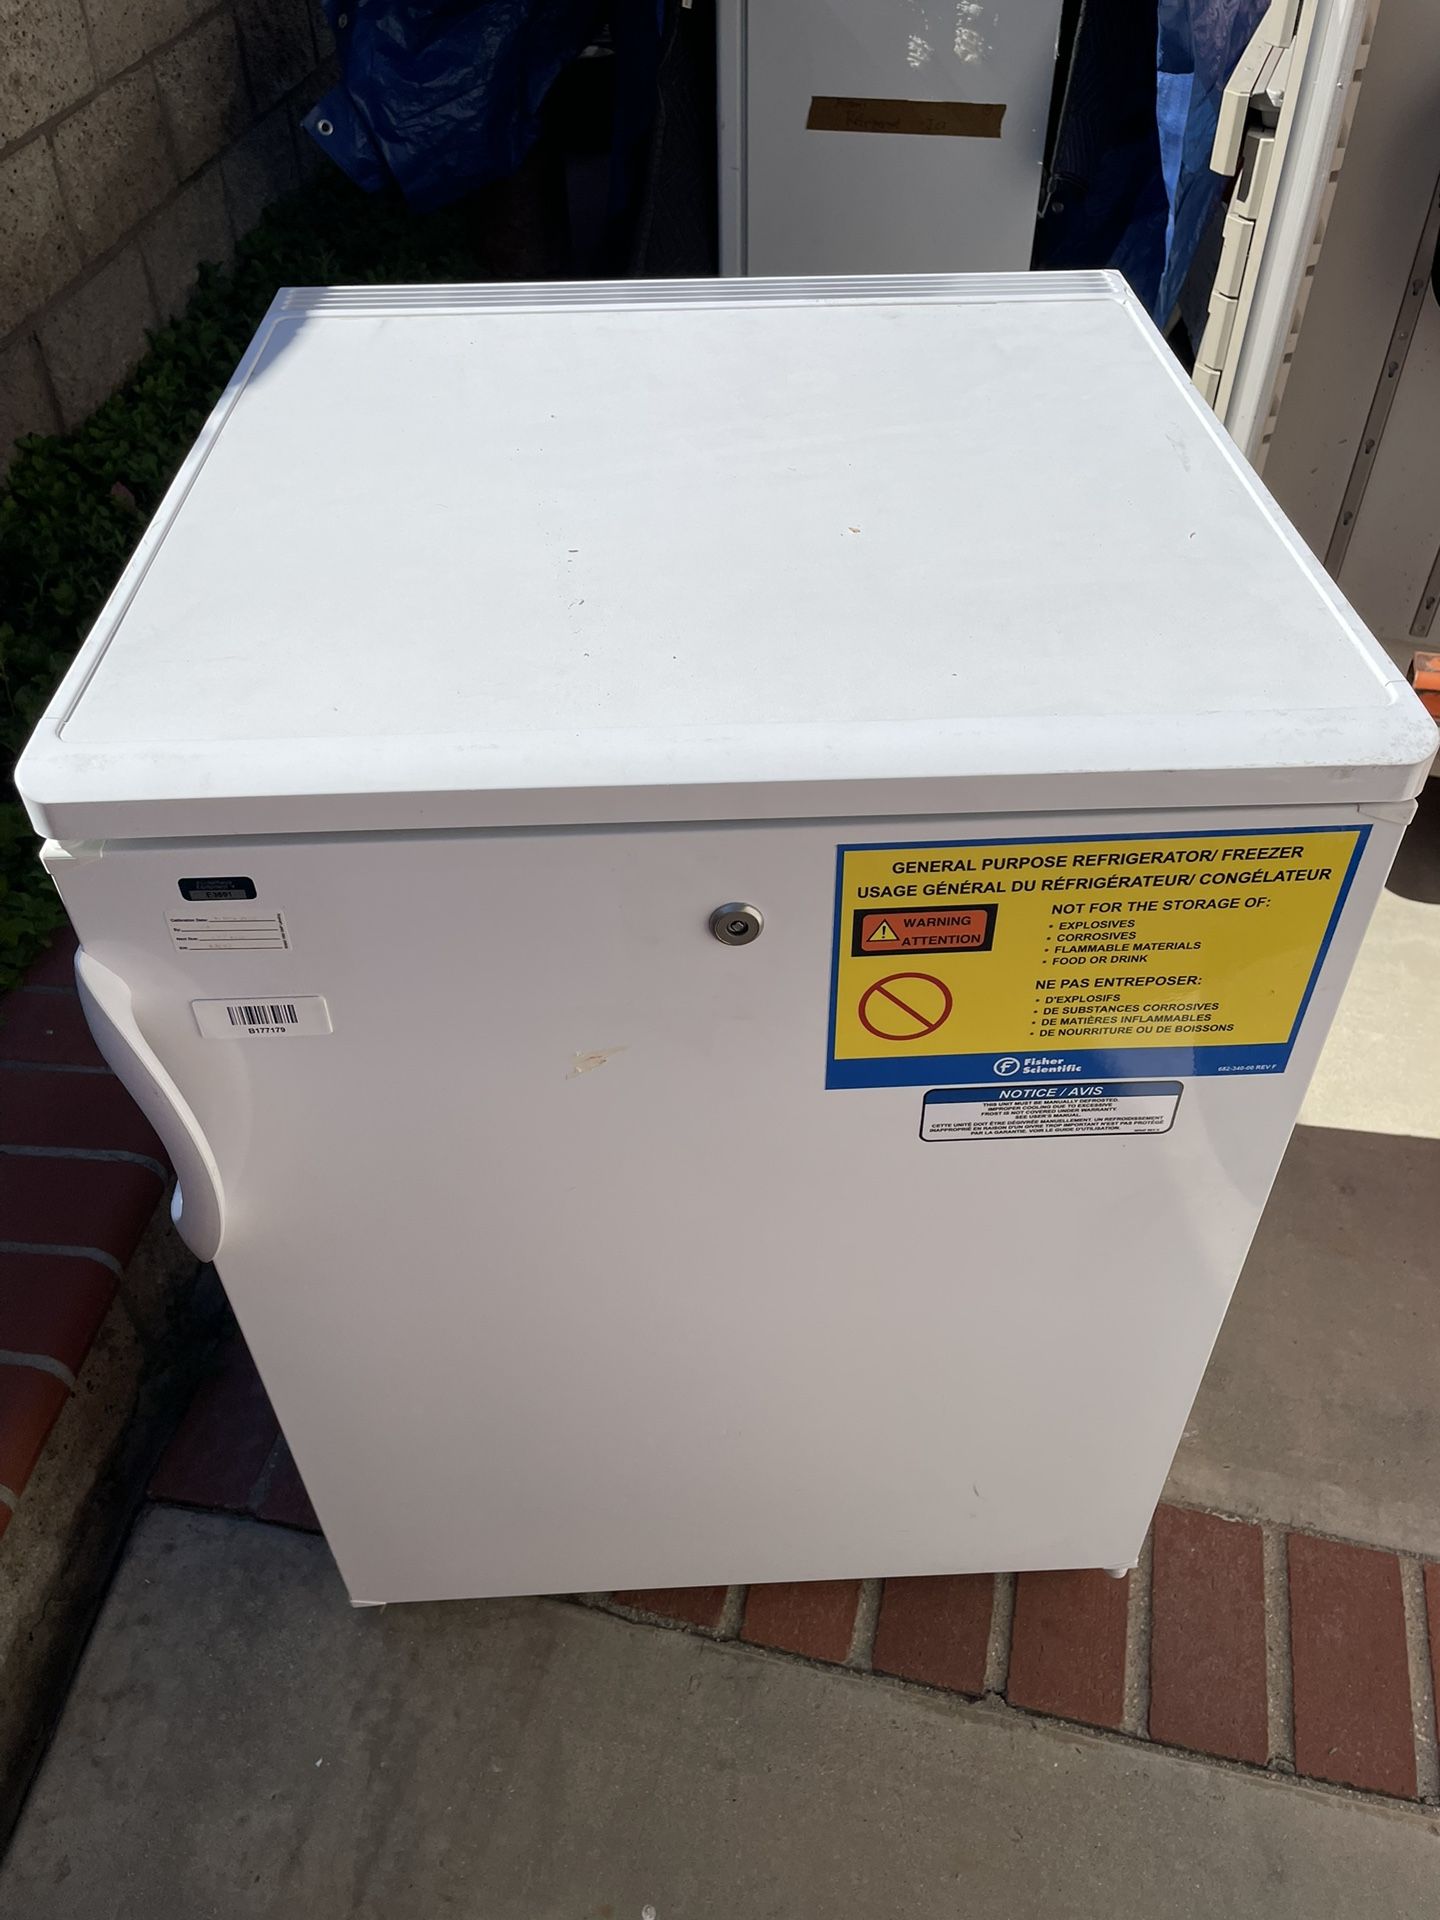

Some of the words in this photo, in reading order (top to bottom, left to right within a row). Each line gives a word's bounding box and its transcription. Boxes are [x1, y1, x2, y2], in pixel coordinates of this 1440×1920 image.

[892, 859, 976, 874] GENERAL
[982, 855, 1067, 871] PURPOSE
[1072, 849, 1218, 867] REFRIGERATOR/
[1221, 846, 1304, 861] FREEZER
[857, 885, 917, 898] USAGE
[923, 880, 1004, 896] GÉNÉRAL
[1011, 880, 1036, 892] DU
[1041, 873, 1196, 891] RÉFRIGÉRATEUR/
[1199, 868, 1332, 885] CONGÉLATEUR
[1051, 903, 1085, 915] NOT
[1089, 902, 1122, 913] FOR
[1128, 900, 1158, 912] THE
[1162, 898, 1240, 911] STORAGE
[1244, 896, 1271, 909] OF:
[903, 916, 971, 928] WARNING
[1058, 919, 1135, 930] EXPLOSIVES
[901, 934, 981, 947] ATTENTION
[1056, 931, 1136, 942] CORROSIVES
[1054, 943, 1129, 954] FLAMMABLE
[1132, 941, 1201, 952] MATERIALS
[1052, 956, 1086, 966] FOOD
[1089, 955, 1107, 964] OR
[1110, 954, 1148, 964] DRINK
[1035, 979, 1056, 990] NE
[1060, 978, 1090, 989] PAS
[1094, 975, 1203, 988] ENTREPOSER:
[1045, 994, 1121, 1004] D'EXPLOSIFS
[1043, 1006, 1059, 1015] DE
[1062, 1004, 1139, 1014] SUBSTANCES
[1142, 1002, 1219, 1012] CORROSIVES
[1041, 1018, 1056, 1026] DE
[1060, 1015, 1117, 1025] MATIÈRES
[1120, 1013, 1212, 1023] INFLAMMABLES
[1039, 1029, 1055, 1037] DE
[1058, 1026, 1133, 1036] NOURRITURE
[1136, 1025, 1153, 1034] OU
[1155, 1025, 1171, 1033] DE
[1174, 1023, 1234, 1033] BOISSONS
[1023, 1057, 1064, 1066] Fisher
[1022, 1064, 1082, 1074] Scientific
[999, 1088, 1058, 1099] NOTICE
[1059, 1087, 1068, 1097] /
[1067, 1086, 1104, 1096] AVIS
